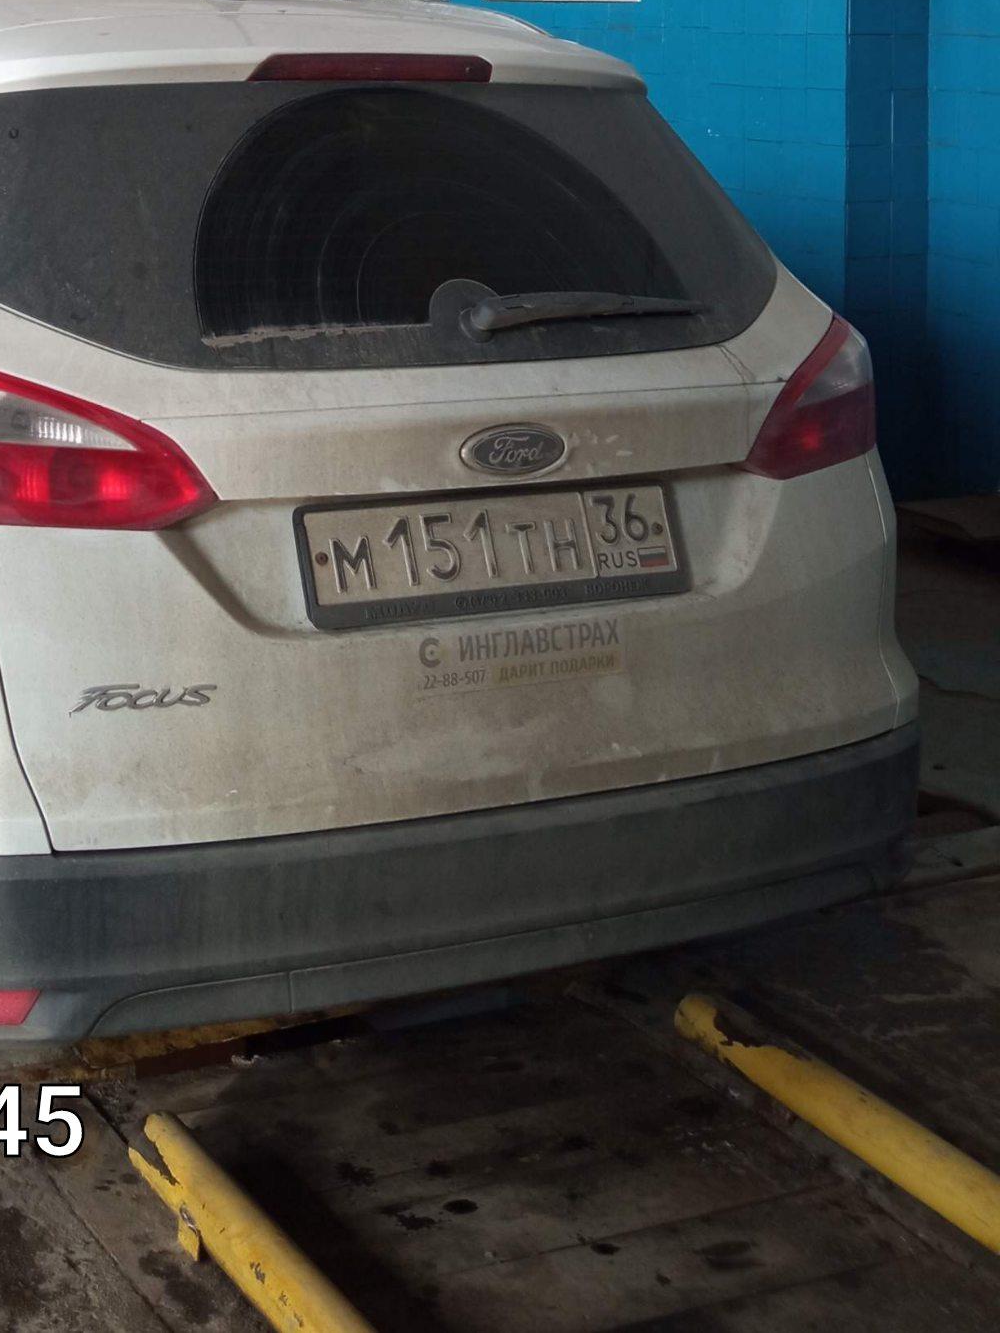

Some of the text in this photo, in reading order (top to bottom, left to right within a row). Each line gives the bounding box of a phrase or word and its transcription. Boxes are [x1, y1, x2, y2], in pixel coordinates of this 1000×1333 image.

[488, 435, 544, 464] Ford
[590, 492, 650, 546] 36
[598, 547, 639, 571] RUS
[458, 618, 620, 663] ИНГЛАВСТРАХ
[423, 653, 616, 690] 22-88-507 ДАРИТ ПОДАРКИ
